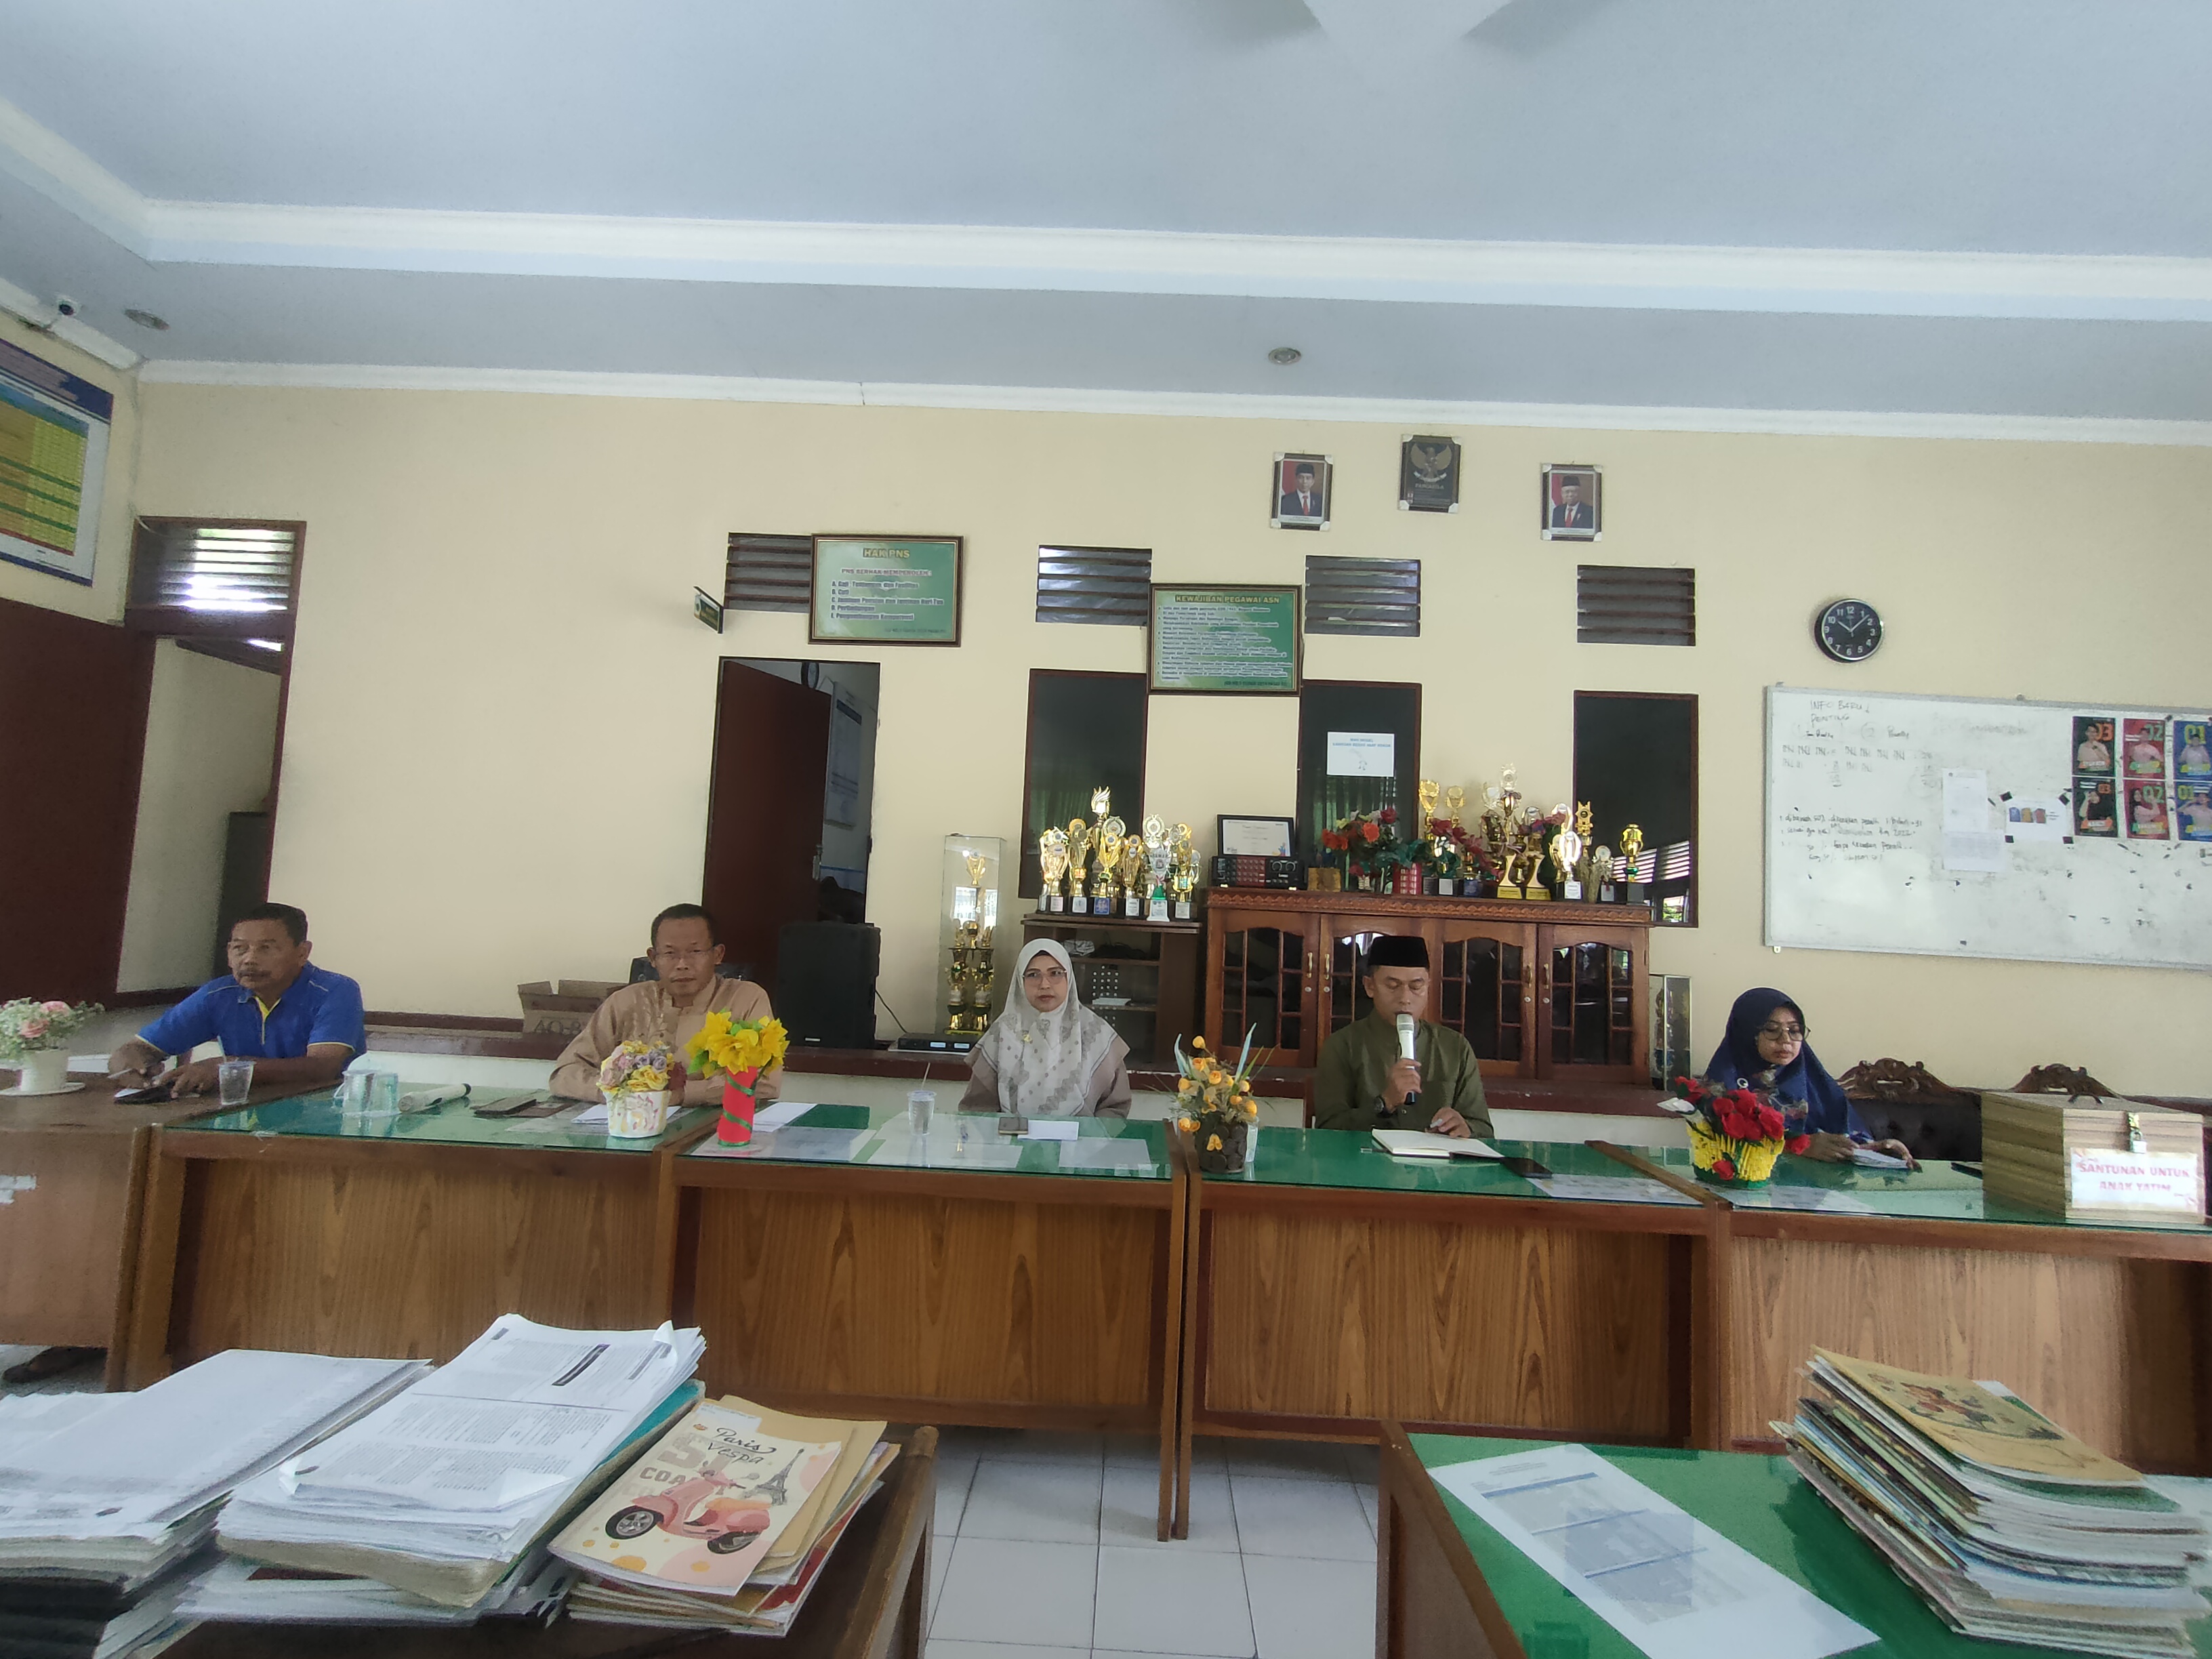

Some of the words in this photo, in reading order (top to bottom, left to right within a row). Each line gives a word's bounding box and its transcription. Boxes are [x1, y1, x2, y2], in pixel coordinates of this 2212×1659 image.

[863, 548, 886, 558] HAK
[888, 549, 910, 558] PNS
[1176, 594, 1223, 602] KEWAJIBAN
[1847, 606, 1854, 614] 12
[2079, 1162, 2146, 1176] SANTUNAN
[2150, 1166, 2190, 1178] UNTUK
[2099, 1181, 2132, 1191] ANAK
[2136, 1182, 2171, 1192] YATIM
[713, 1428, 775, 1454] Paris
[708, 1442, 764, 1465] Vespa
